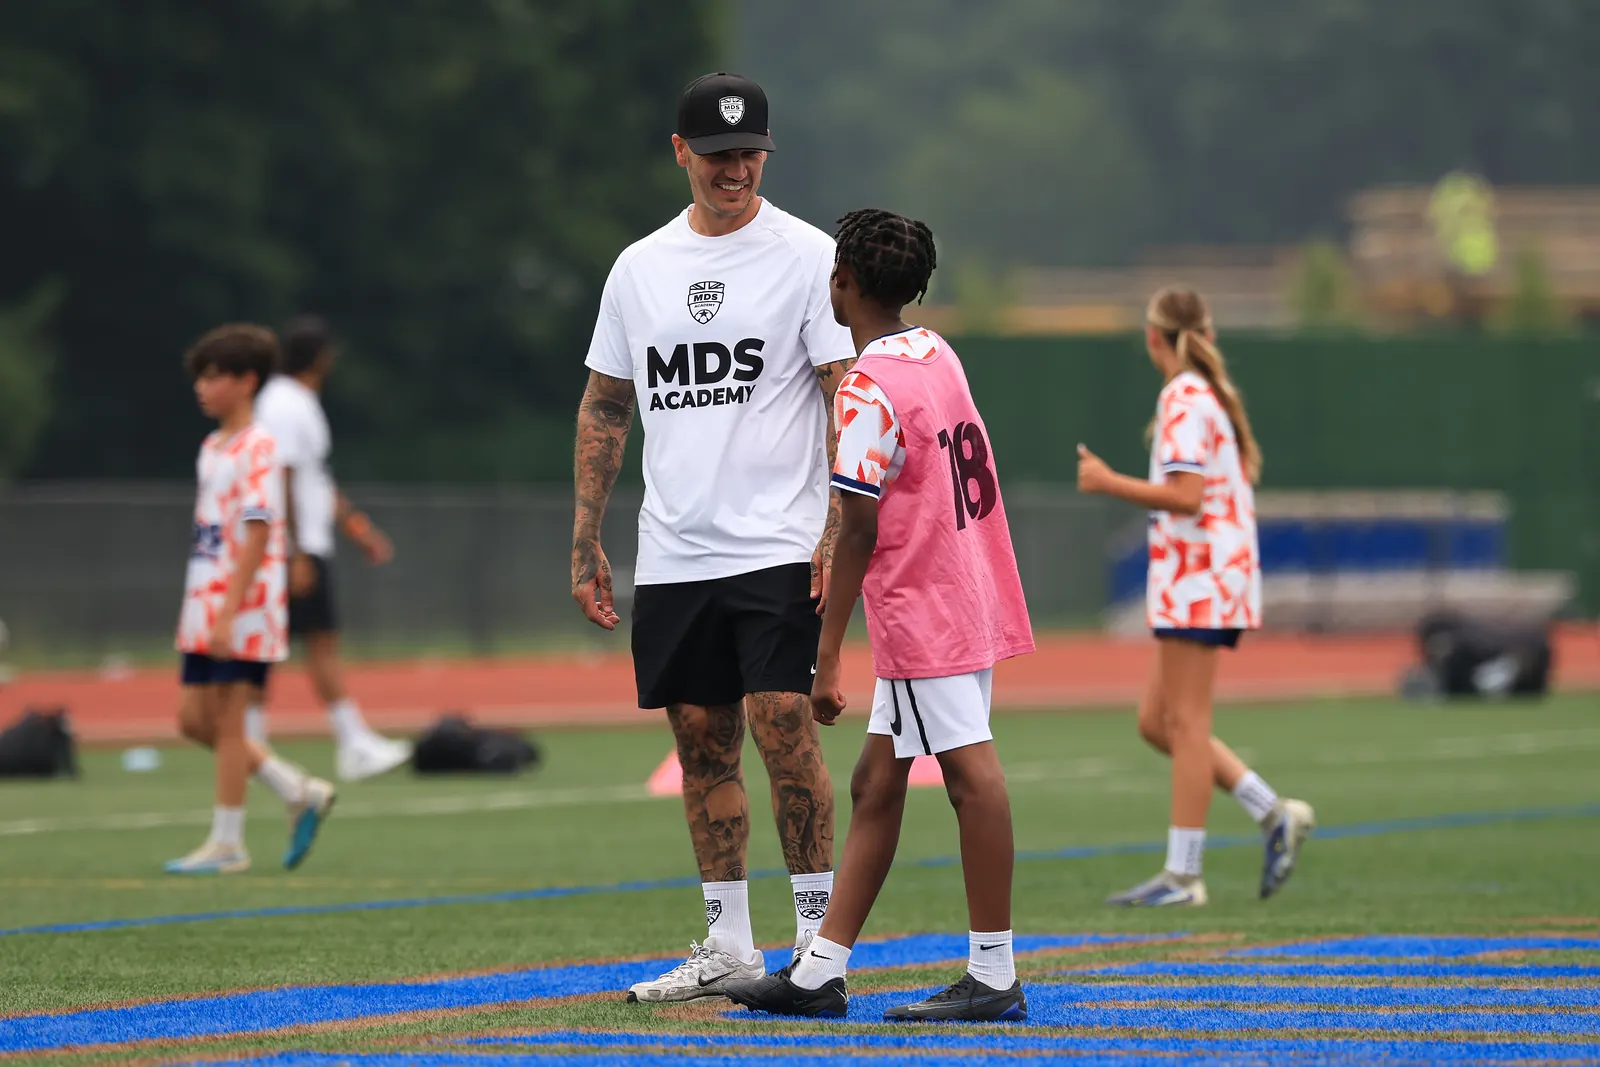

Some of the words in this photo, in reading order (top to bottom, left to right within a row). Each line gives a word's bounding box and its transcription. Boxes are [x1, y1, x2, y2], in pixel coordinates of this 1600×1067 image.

[693, 293, 718, 302] MDS
[647, 338, 765, 388] MDS
[649, 385, 756, 411] ACADEMY
[937, 421, 996, 531] 18
